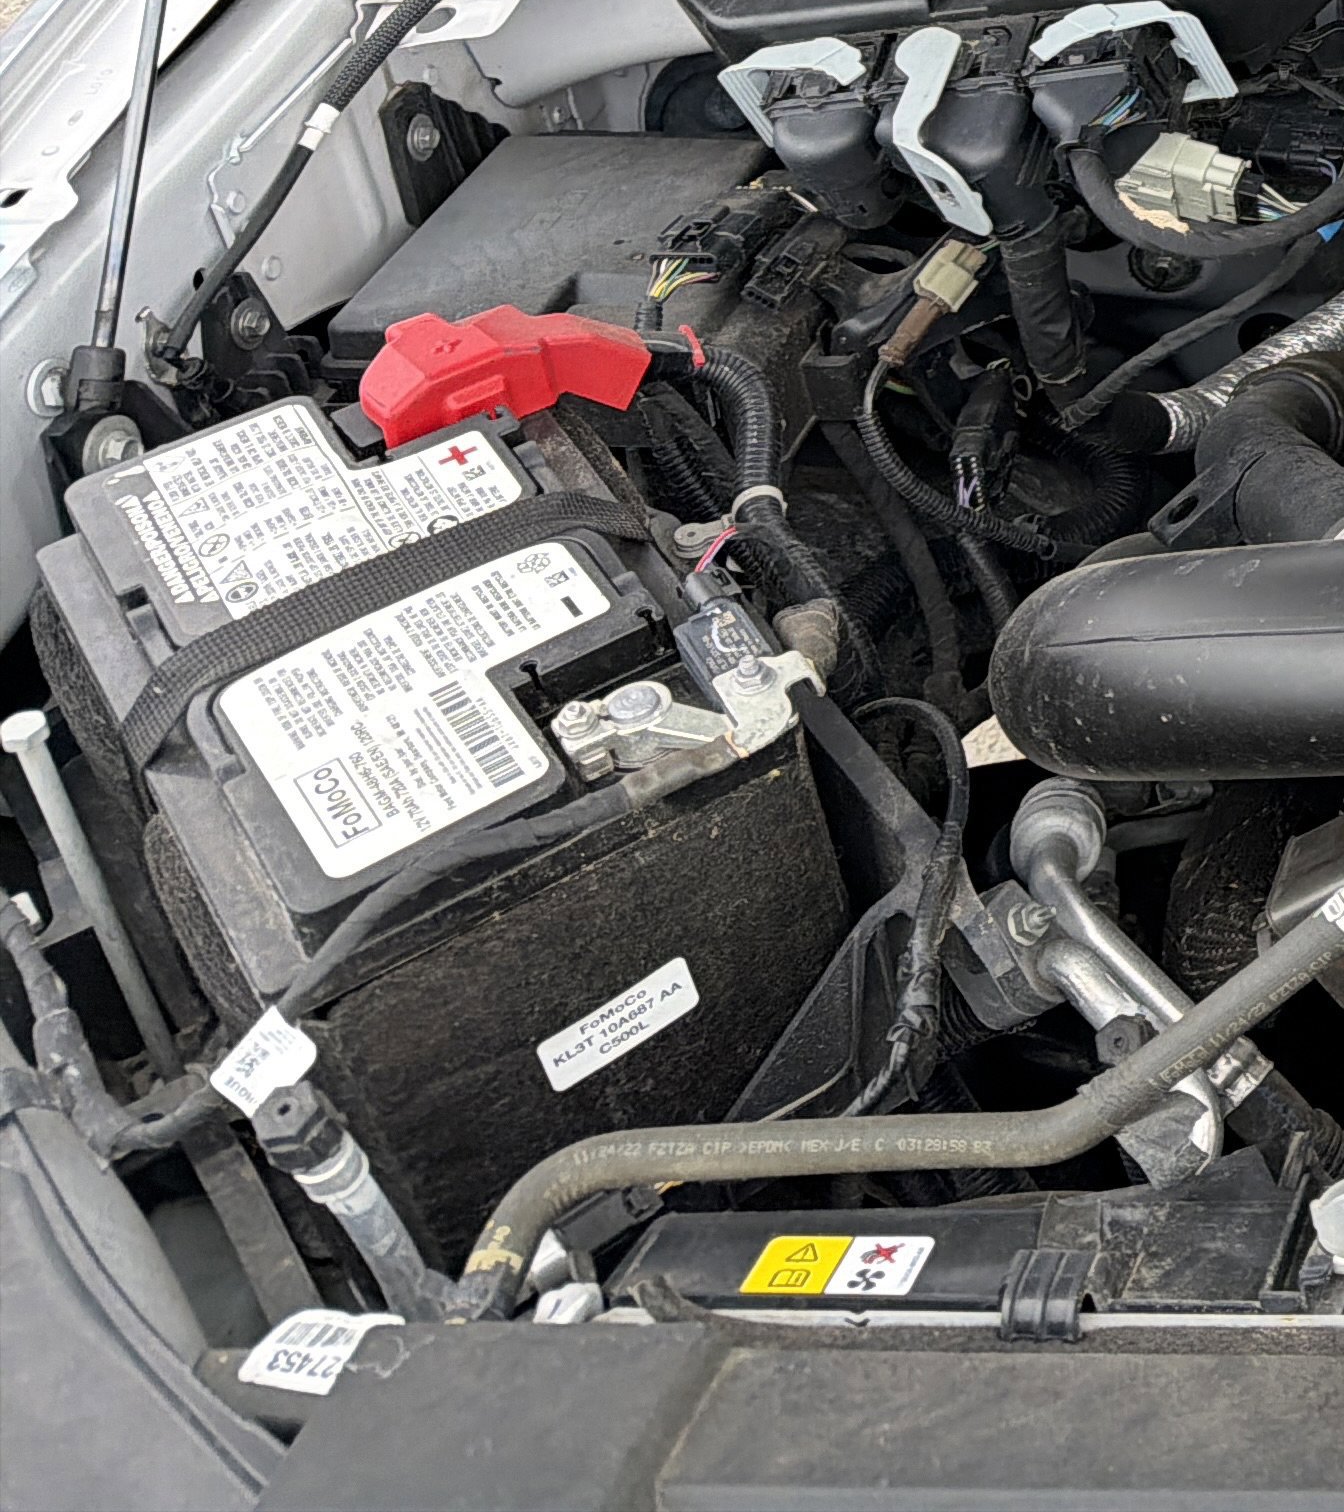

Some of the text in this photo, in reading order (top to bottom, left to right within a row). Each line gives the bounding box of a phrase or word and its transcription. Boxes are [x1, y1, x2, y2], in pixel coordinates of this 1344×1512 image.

[309, 764, 370, 841] FoMoCo
[552, 982, 682, 1067] KL3T 10A687 AA
[579, 989, 647, 1035] FoMoCo
[599, 1021, 650, 1055] C500L
[801, 1138, 829, 1153] MEX
[265, 1348, 342, 1379] 27453
